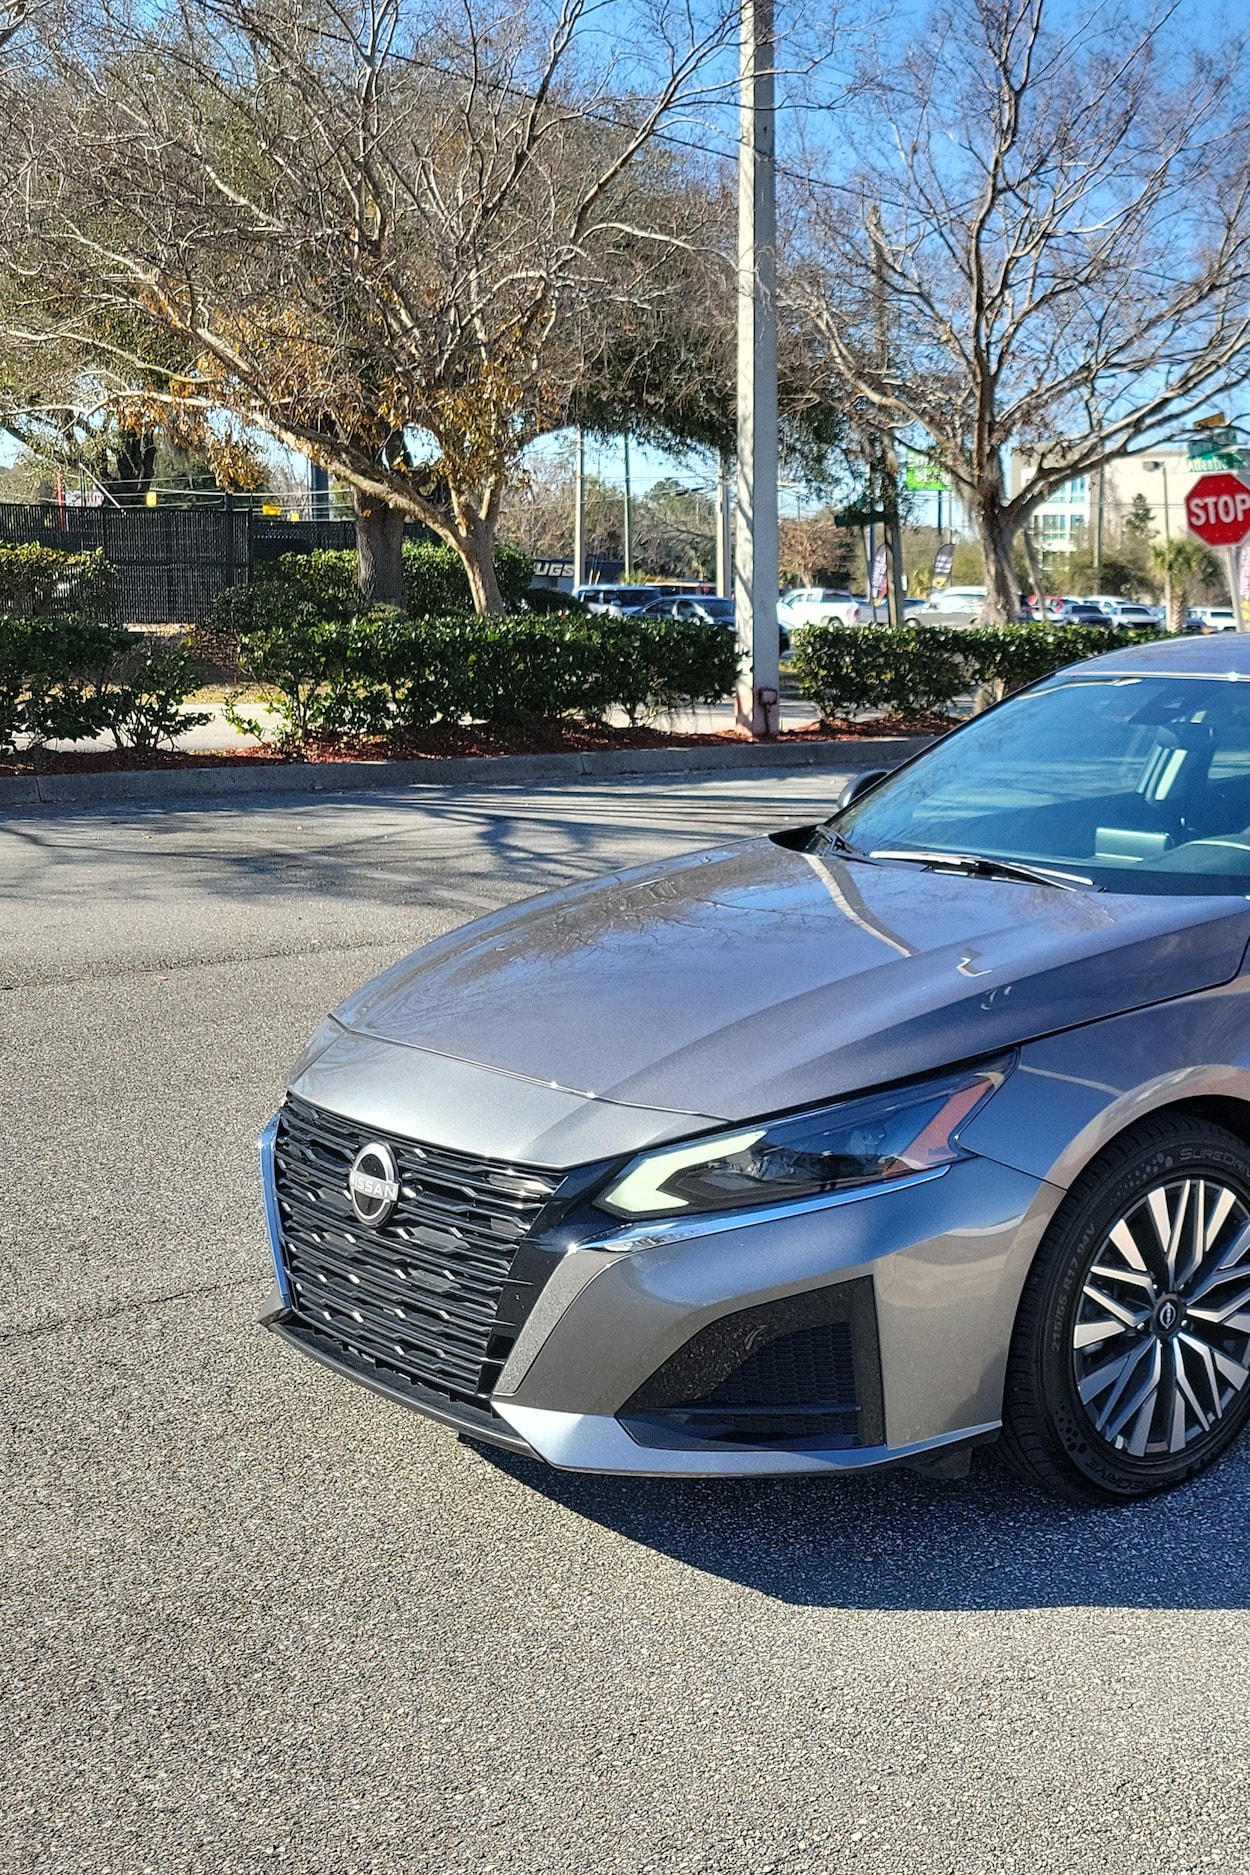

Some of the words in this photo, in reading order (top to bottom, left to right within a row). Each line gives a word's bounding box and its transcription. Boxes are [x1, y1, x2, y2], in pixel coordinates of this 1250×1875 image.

[533, 561, 575, 578] UGS
[351, 1171, 397, 1199] NISSAN
[1085, 1459, 1181, 1491] UREDRIVE
